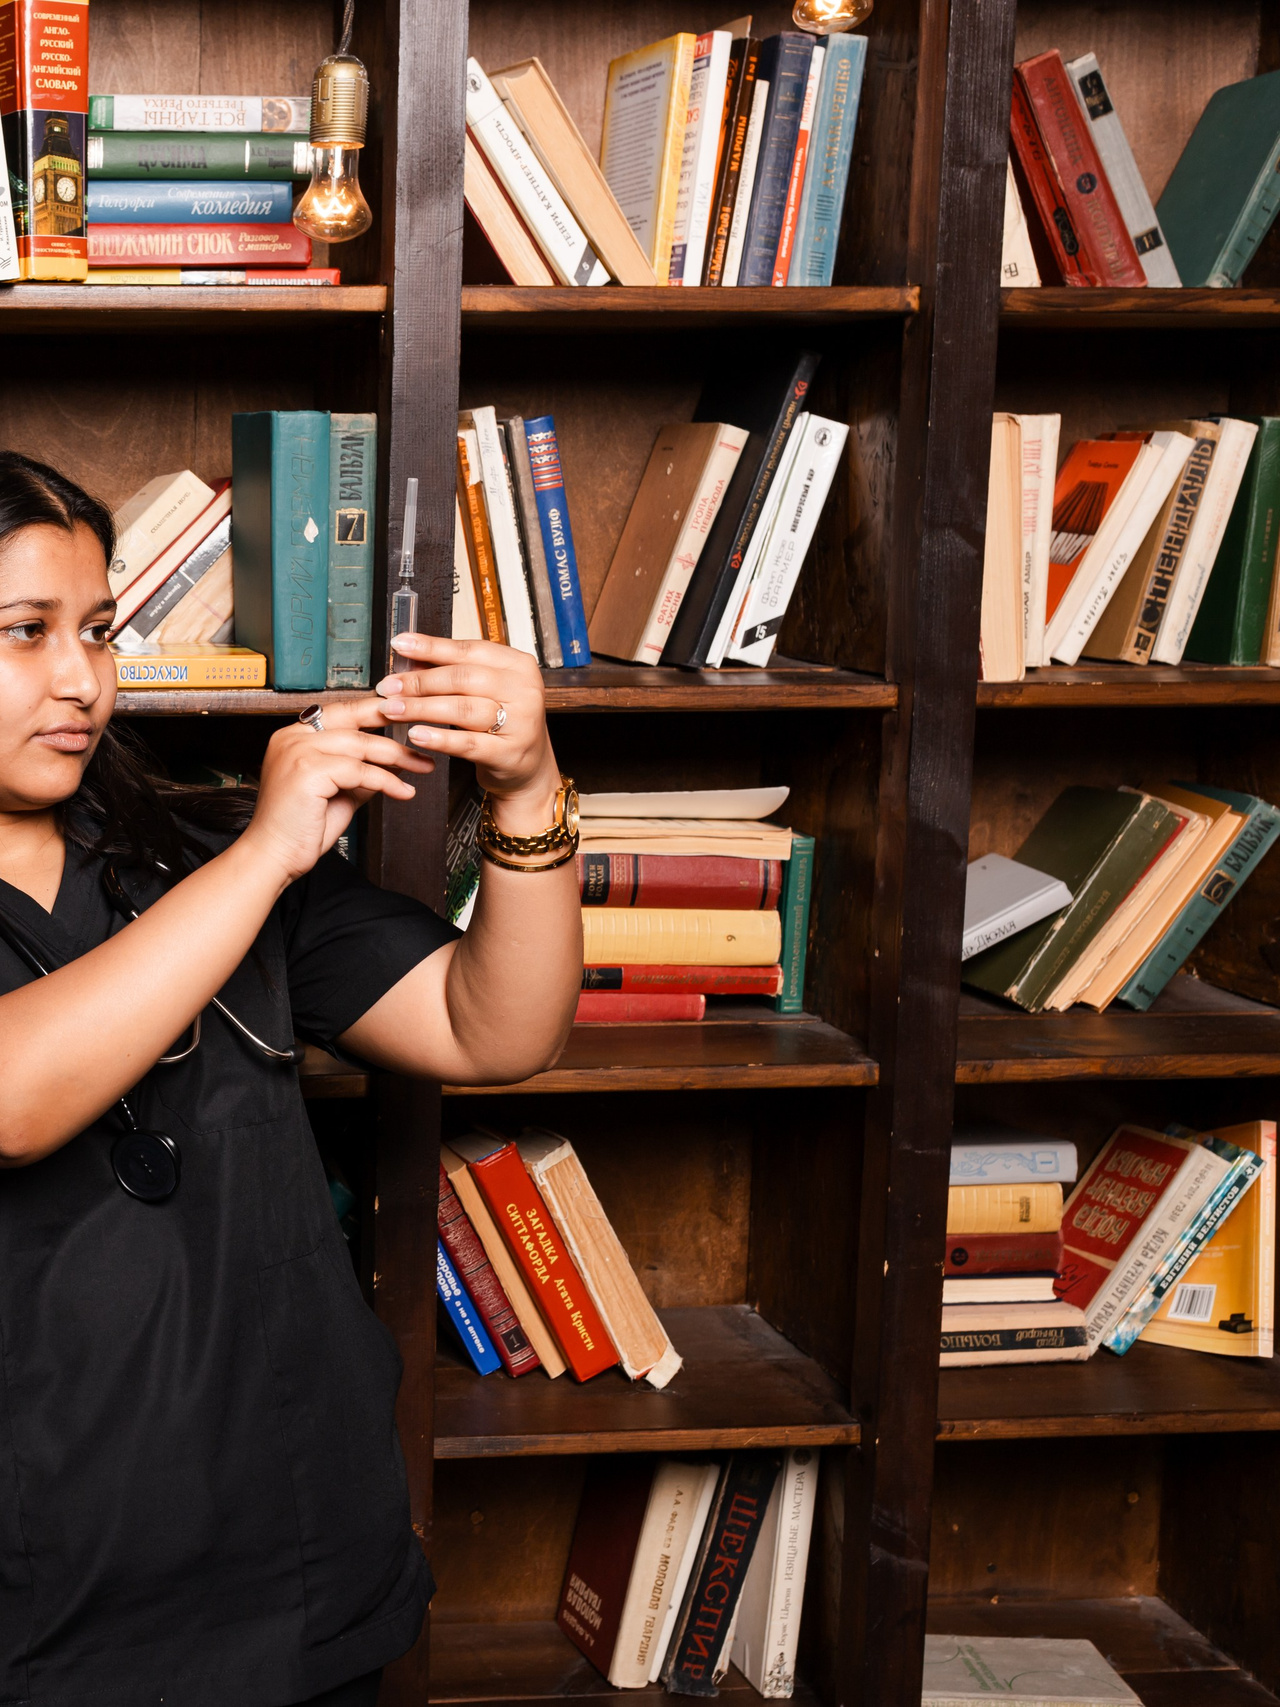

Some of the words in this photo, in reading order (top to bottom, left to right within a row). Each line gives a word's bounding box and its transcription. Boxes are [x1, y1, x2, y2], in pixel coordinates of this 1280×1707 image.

[33, 12, 80, 23] СОВРЕМЕННЫЙ
[43, 25, 70, 36] АНГЛО-
[39, 38, 74, 50] РУССКИЙ
[41, 52, 72, 62] РУССКО-
[31, 64, 82, 77] АНГЛИЙСКИЙ
[35, 78, 78, 91] СЛОВАРЬ
[143, 110, 209, 128] ТАЙНЫ
[211, 110, 247, 127] ВСЕ
[821, 58, 851, 190] А.С.МАКАРЕНКО
[190, 192, 273, 216] комедия
[710, 237, 724, 271] Майн
[717, 211, 730, 235] Рид
[729, 115, 747, 171] МАРОНЫ
[88, 233, 183, 258] ЕНДЖАМИН
[187, 233, 235, 255] СПОК
[238, 233, 280, 244] Разговор
[548, 211, 576, 247] ГЕНРИ
[245, 241, 292, 254] матерью
[1023, 438, 1043, 479] ДУША
[346, 515, 362, 541] 7
[546, 506, 566, 546] ВУЛФ
[1140, 437, 1216, 633] СТЕНДАЛЬ
[655, 588, 675, 624] ФАТИХ
[689, 494, 709, 530] ТРОПА
[663, 590, 682, 627] ХУСНИ
[698, 477, 726, 534] ПЕШЕХОДА
[552, 548, 574, 600] ТОМАС
[291, 556, 314, 642] ЮРИЙ
[489, 611, 501, 643] Майн
[754, 625, 767, 640] 15
[119, 664, 187, 682] ИСКУССТВО
[1223, 812, 1275, 873] БАЛЬЗАК
[587, 863, 595, 896] РОМЕН
[795, 856, 808, 900] СЛОВАРЬ
[786, 904, 805, 997] ОРФОГРАФИЧЕСКИЙ
[974, 920, 1017, 951] ДЮМА
[526, 1208, 559, 1265] ЗАГАДКА
[1160, 1240, 1197, 1290] ЕВГЕНИЙ
[1197, 1185, 1239, 1241] ВЕЛТИСТОВ
[506, 1203, 551, 1285] СИТТАФОРДА
[554, 1278, 574, 1311] Агата
[570, 1311, 595, 1351] Кристи
[466, 1324, 486, 1354] аптеке
[791, 1470, 806, 1521] МАСТЕРА
[784, 1524, 800, 1581] ИЗЯЩНЫЕ
[648, 1553, 671, 1610] МОЛОДАЯ
[682, 1493, 758, 1680] ШЕКСПИР
[636, 1614, 656, 1666] ГВАРДИЯ
[777, 1622, 786, 1647] Борис
